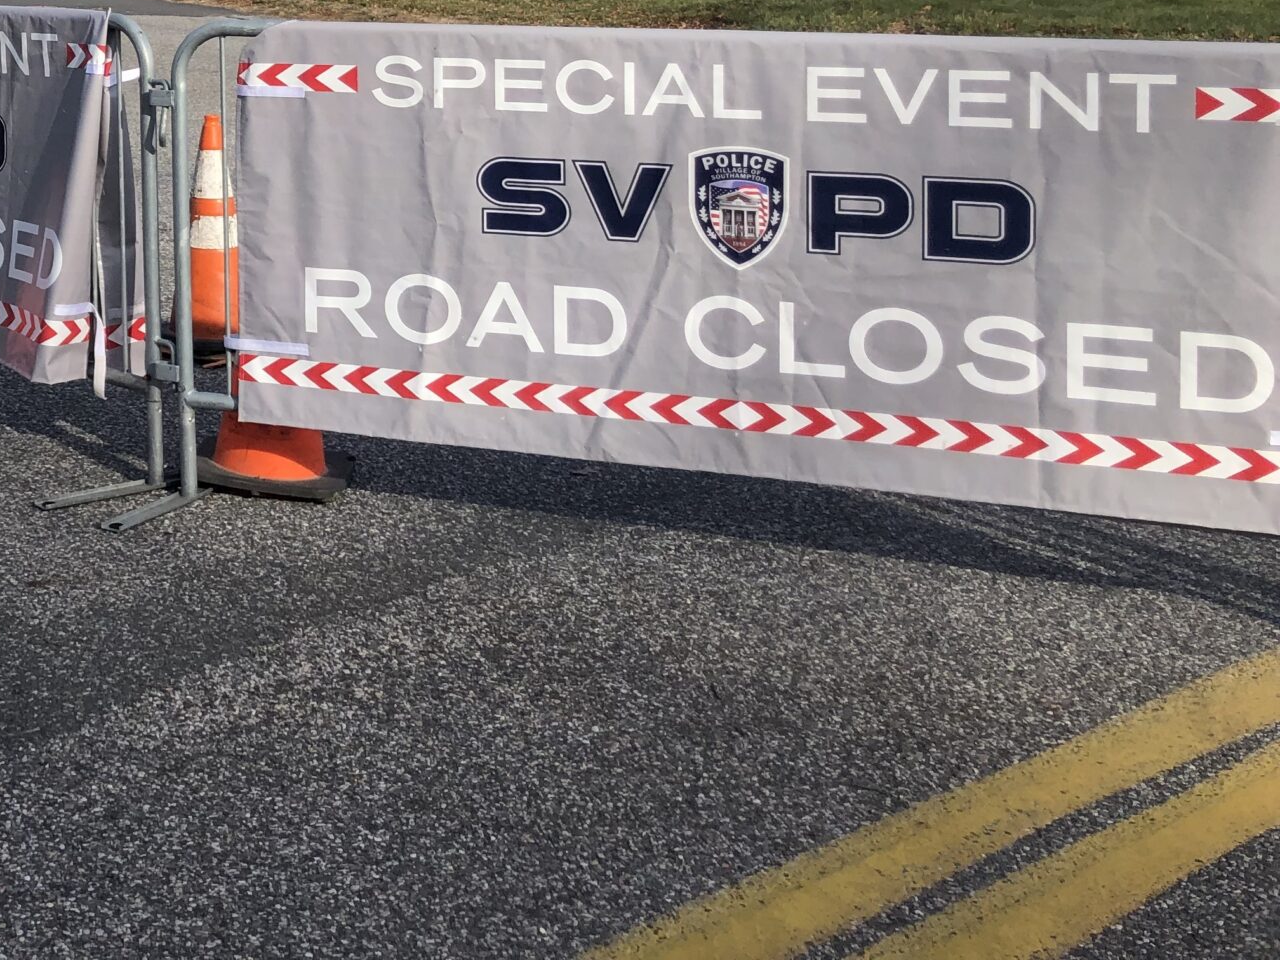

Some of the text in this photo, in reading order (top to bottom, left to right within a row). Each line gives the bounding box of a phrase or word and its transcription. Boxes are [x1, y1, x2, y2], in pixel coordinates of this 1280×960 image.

[371, 54, 1177, 133] SPECIAL EVENT
[701, 153, 777, 173] POLICE
[711, 173, 767, 183] SOUTHAMPTON
[477, 156, 1037, 265] SV PD
[304, 267, 1275, 414] ROAD CLOSED
